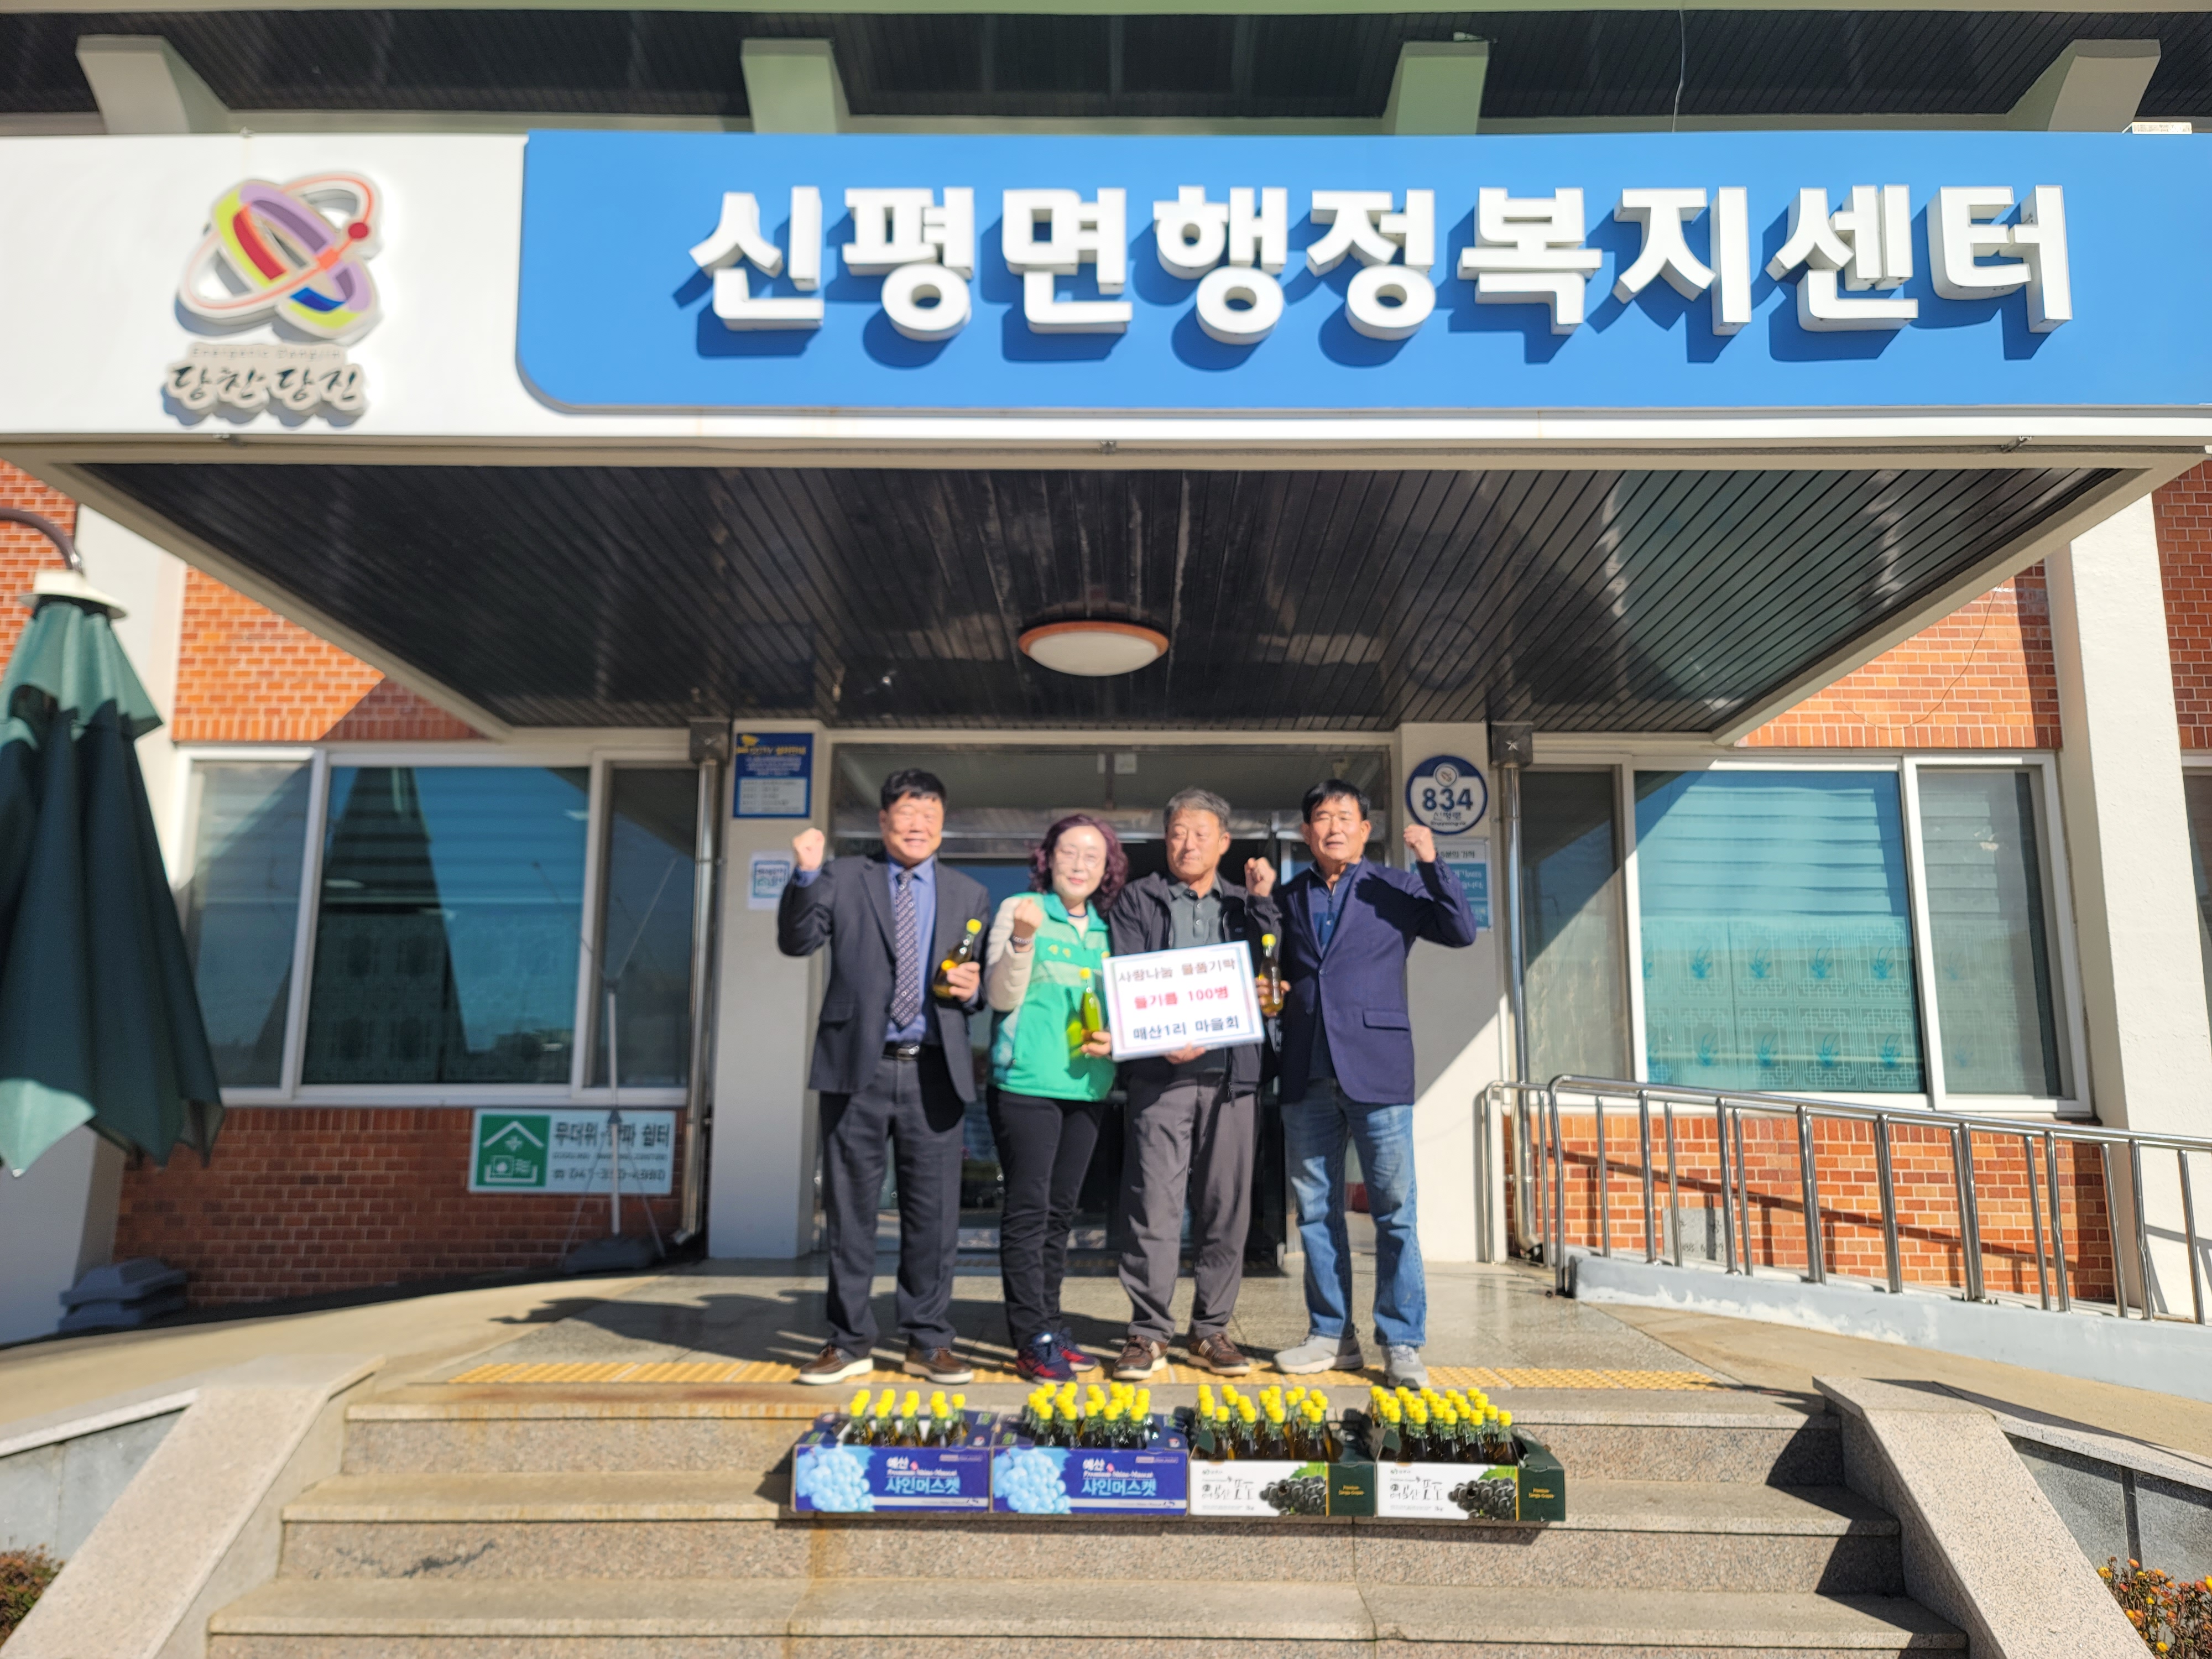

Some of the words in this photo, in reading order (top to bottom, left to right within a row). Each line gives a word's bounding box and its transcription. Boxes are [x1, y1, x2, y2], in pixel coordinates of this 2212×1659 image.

[689, 185, 2073, 343] 신평면행정복지센터
[275, 367, 357, 403] 당진
[1422, 787, 1473, 811] 834
[1188, 985, 1229, 1002] 100병
[1133, 1022, 1187, 1040] 매산1리
[1195, 1015, 1239, 1033] 마을회
[886, 1457, 909, 1469] 예산
[1083, 1459, 1105, 1472] 예산
[885, 1477, 961, 1495] 샤인머스켓
[1081, 1479, 1157, 1497] 샤인머스켓
